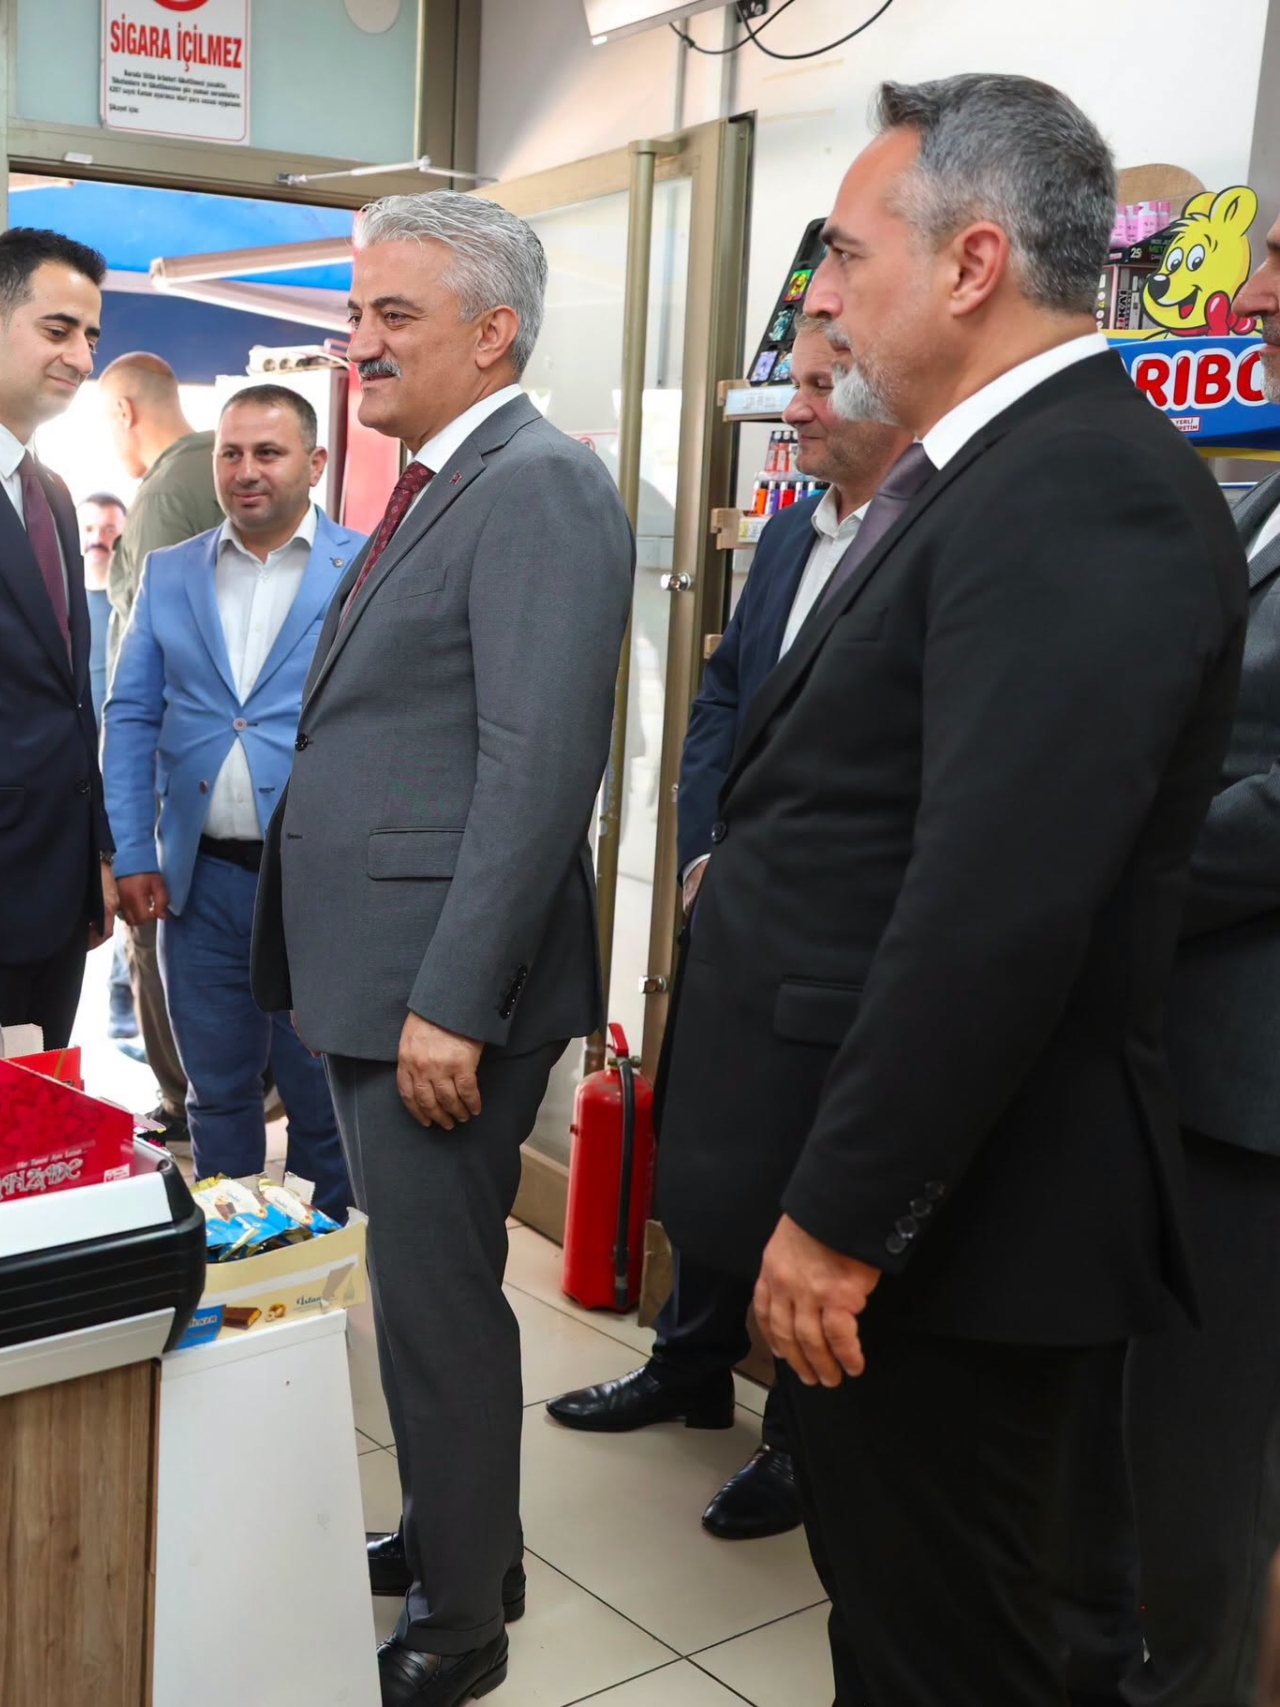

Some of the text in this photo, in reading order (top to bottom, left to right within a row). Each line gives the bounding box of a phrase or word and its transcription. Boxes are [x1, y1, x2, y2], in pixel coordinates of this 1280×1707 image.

[110, 13, 242, 72] SİGARA İÇİLMEZ
[1135, 350, 1265, 407] RIBO
